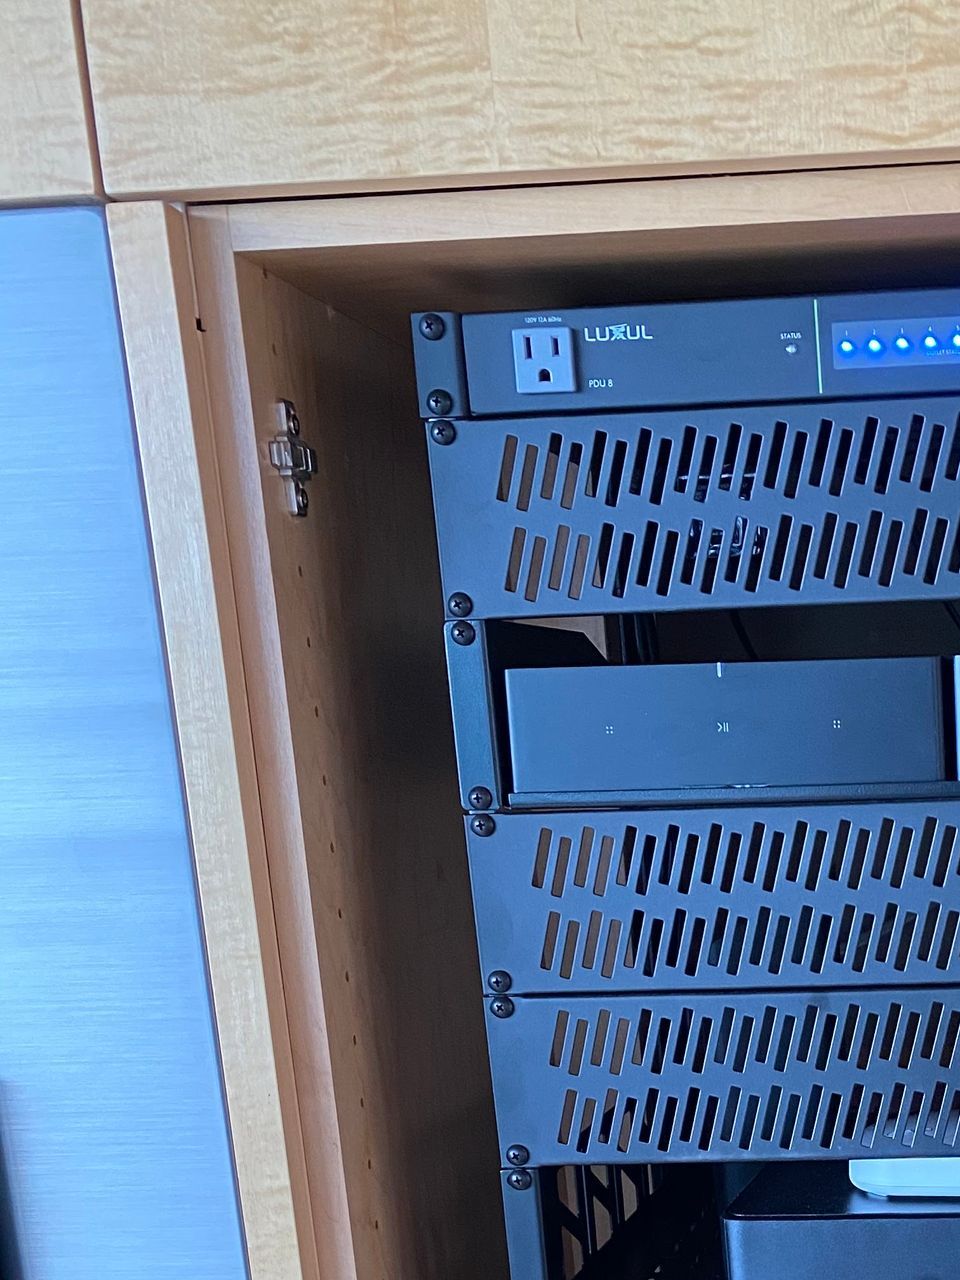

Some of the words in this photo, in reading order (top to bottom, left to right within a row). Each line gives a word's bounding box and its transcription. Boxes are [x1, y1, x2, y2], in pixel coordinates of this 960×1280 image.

[584, 323, 654, 342] LUXUL
[780, 332, 802, 340] STATUS
[588, 379, 606, 388] PDU
[607, 378, 614, 388] 8
